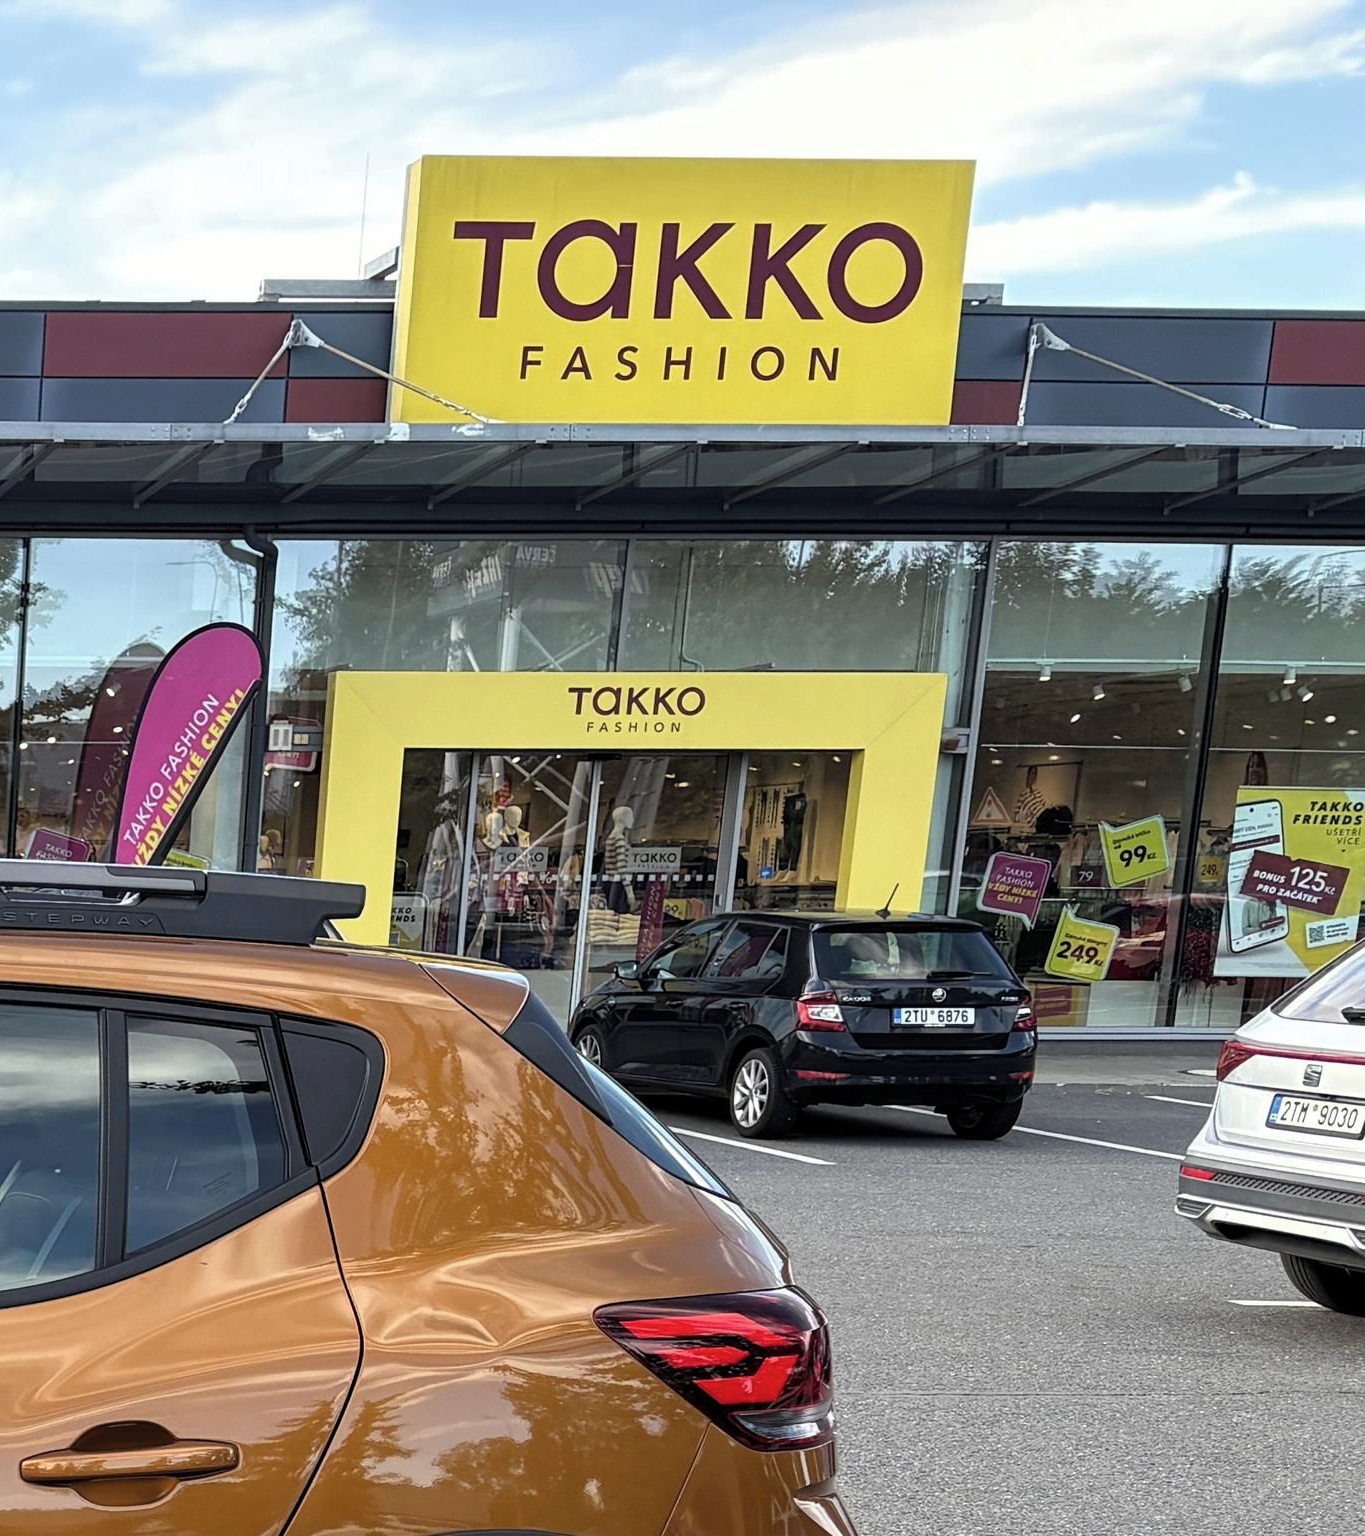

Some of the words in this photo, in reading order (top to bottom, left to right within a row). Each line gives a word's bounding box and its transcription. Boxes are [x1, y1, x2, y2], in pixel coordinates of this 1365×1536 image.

[519, 346, 840, 381] FASHION
[586, 722, 681, 733] FASHION
[124, 781, 164, 845] TAKKO
[160, 693, 219, 780] FASHION
[162, 751, 205, 816] NÍZKÉ
[1310, 801, 1364, 811] TAKKO
[1293, 814, 1363, 825] FRIENDS
[1120, 845, 1147, 867] 99
[1005, 867, 1033, 878] TAKKO
[1078, 871, 1094, 881] 79
[1253, 870, 1286, 883] BONUS
[1290, 866, 1329, 892] 125
[997, 874, 1034, 888] FASHION
[1256, 884, 1276, 894] PRO
[3, 911, 153, 926] STEPWAY
[1056, 941, 1099, 964] 249
[904, 1010, 928, 1023] 2TU
[938, 1010, 969, 1023] 6876
[1280, 1101, 1310, 1123] 2TM
[1318, 1105, 1359, 1129] 9030
